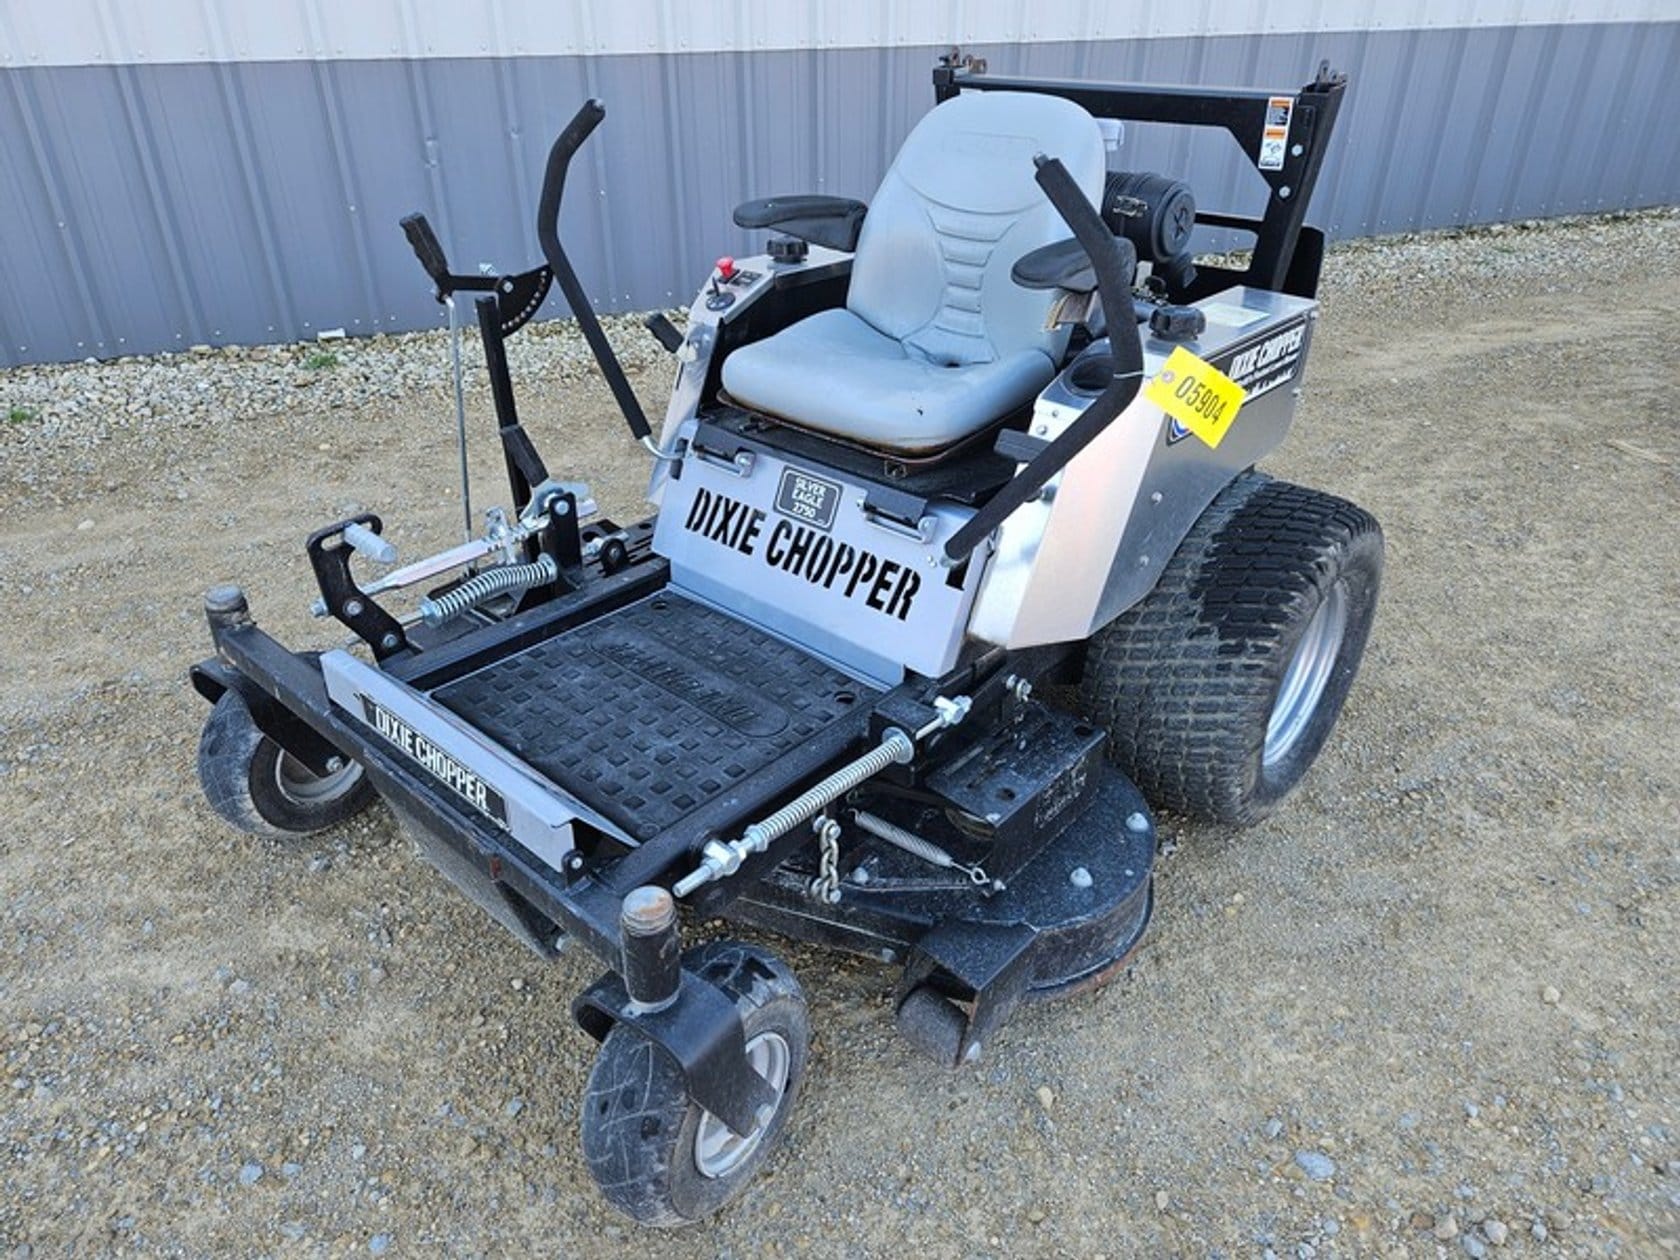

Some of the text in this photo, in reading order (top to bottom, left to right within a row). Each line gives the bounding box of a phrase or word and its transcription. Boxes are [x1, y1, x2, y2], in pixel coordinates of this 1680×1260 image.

[1257, 324, 1306, 368] CHOPPER
[1175, 376, 1227, 425] 05904
[792, 488, 824, 510] EAGLE
[685, 488, 921, 621] DIXIE CHOPPER
[376, 706, 488, 809] DIXIE CHOPPER
